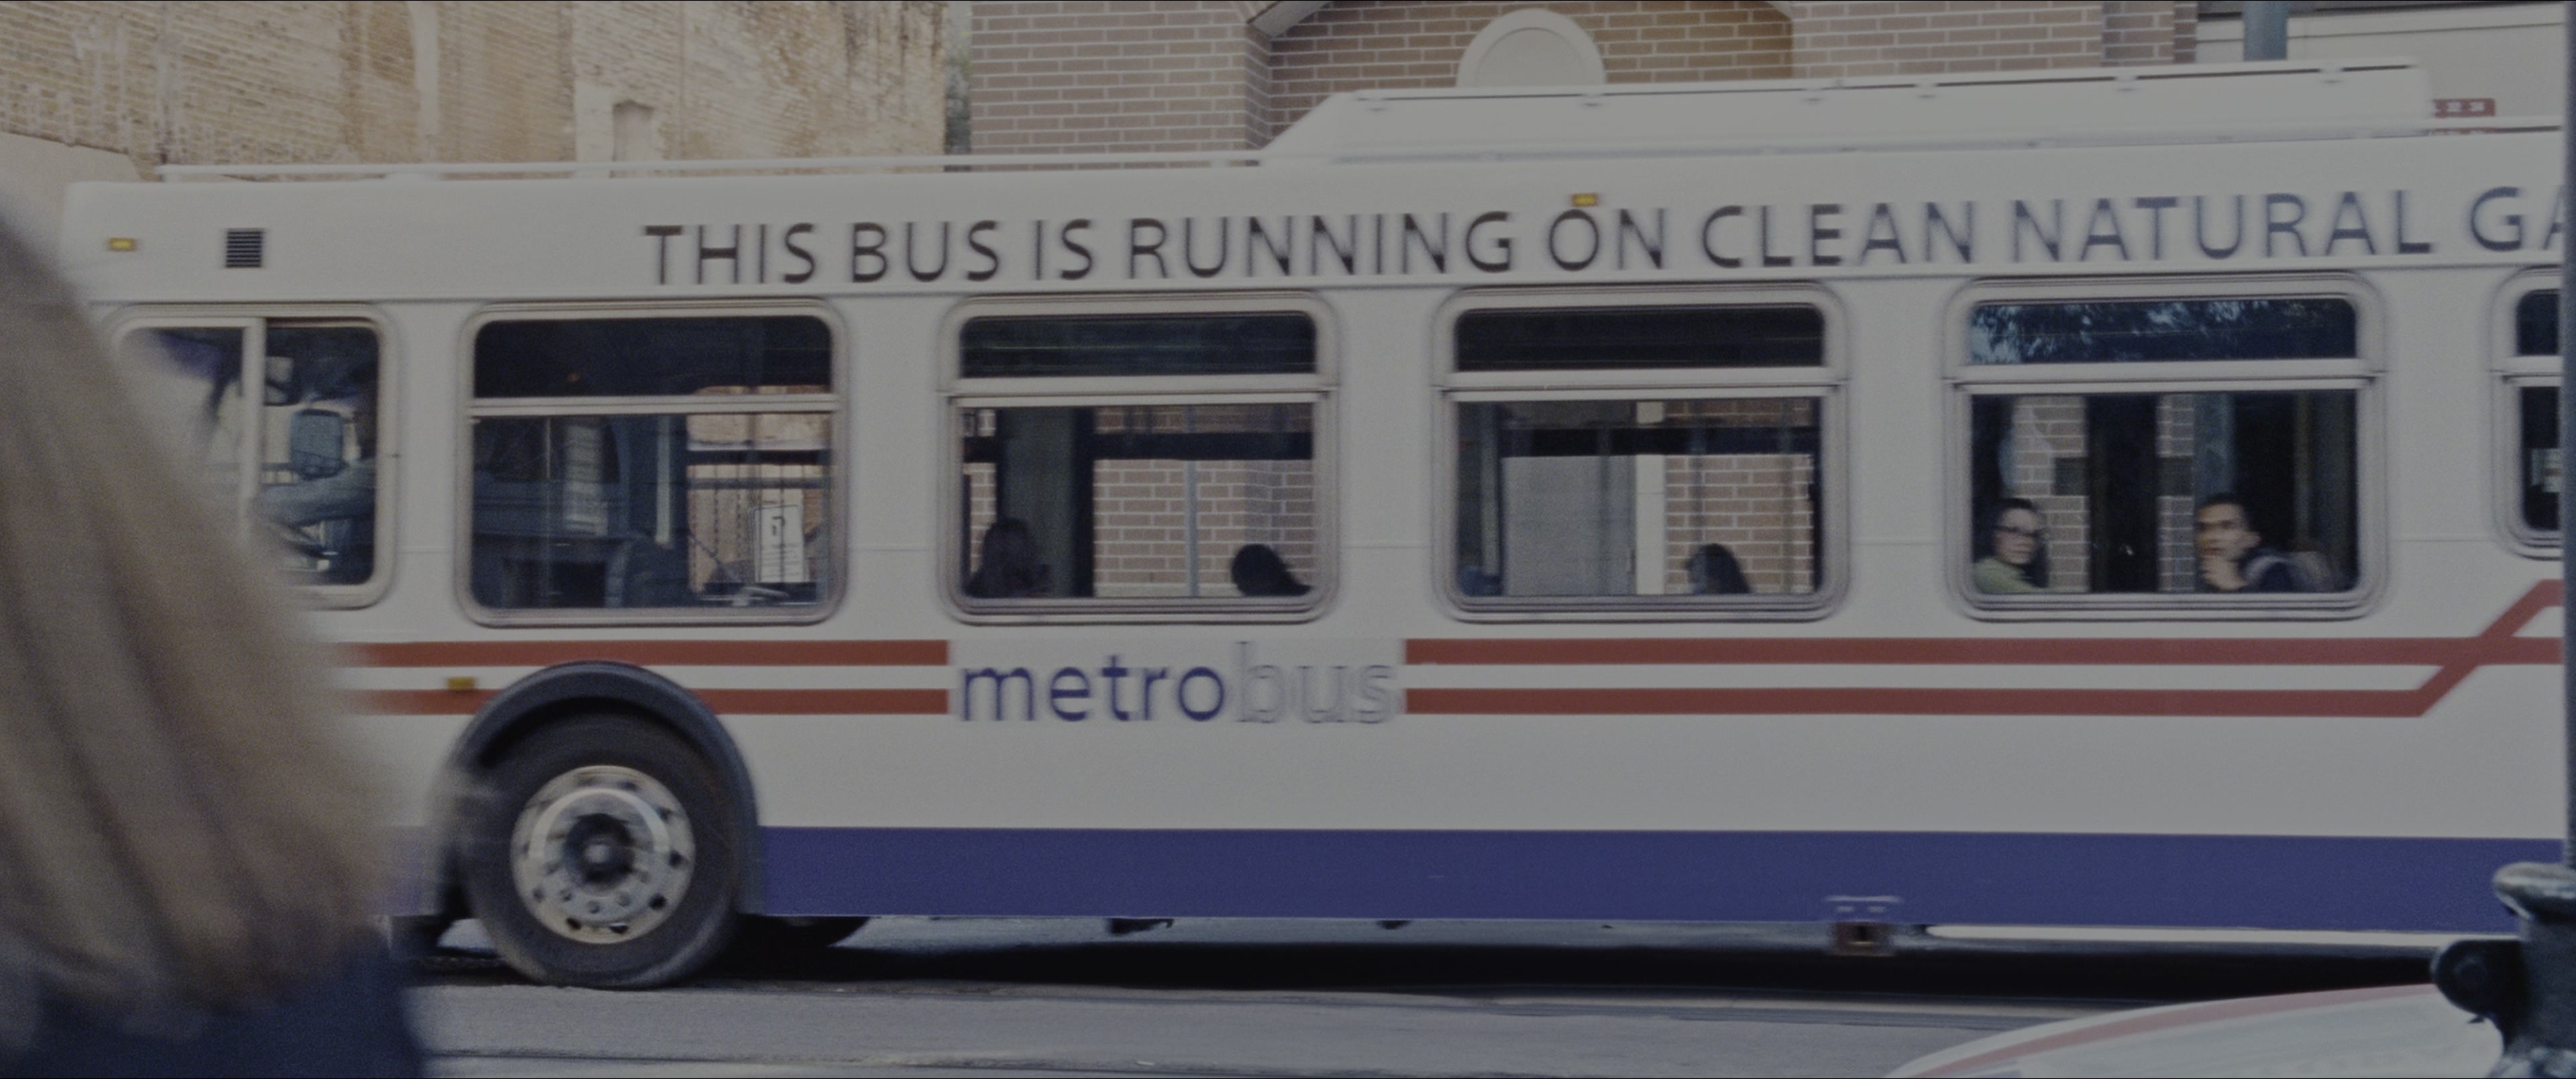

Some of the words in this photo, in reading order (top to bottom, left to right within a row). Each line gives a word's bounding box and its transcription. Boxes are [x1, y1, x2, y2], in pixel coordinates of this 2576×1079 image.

[644, 223, 817, 285] THIS
[851, 221, 1001, 283] BUS
[1036, 218, 1095, 280] IS
[1128, 210, 1513, 279] RUNNING
[1548, 207, 1665, 271] ON
[1701, 201, 1974, 268] CLEAN
[2010, 189, 2432, 264] NATURAL
[959, 639, 1399, 724] metrobus
